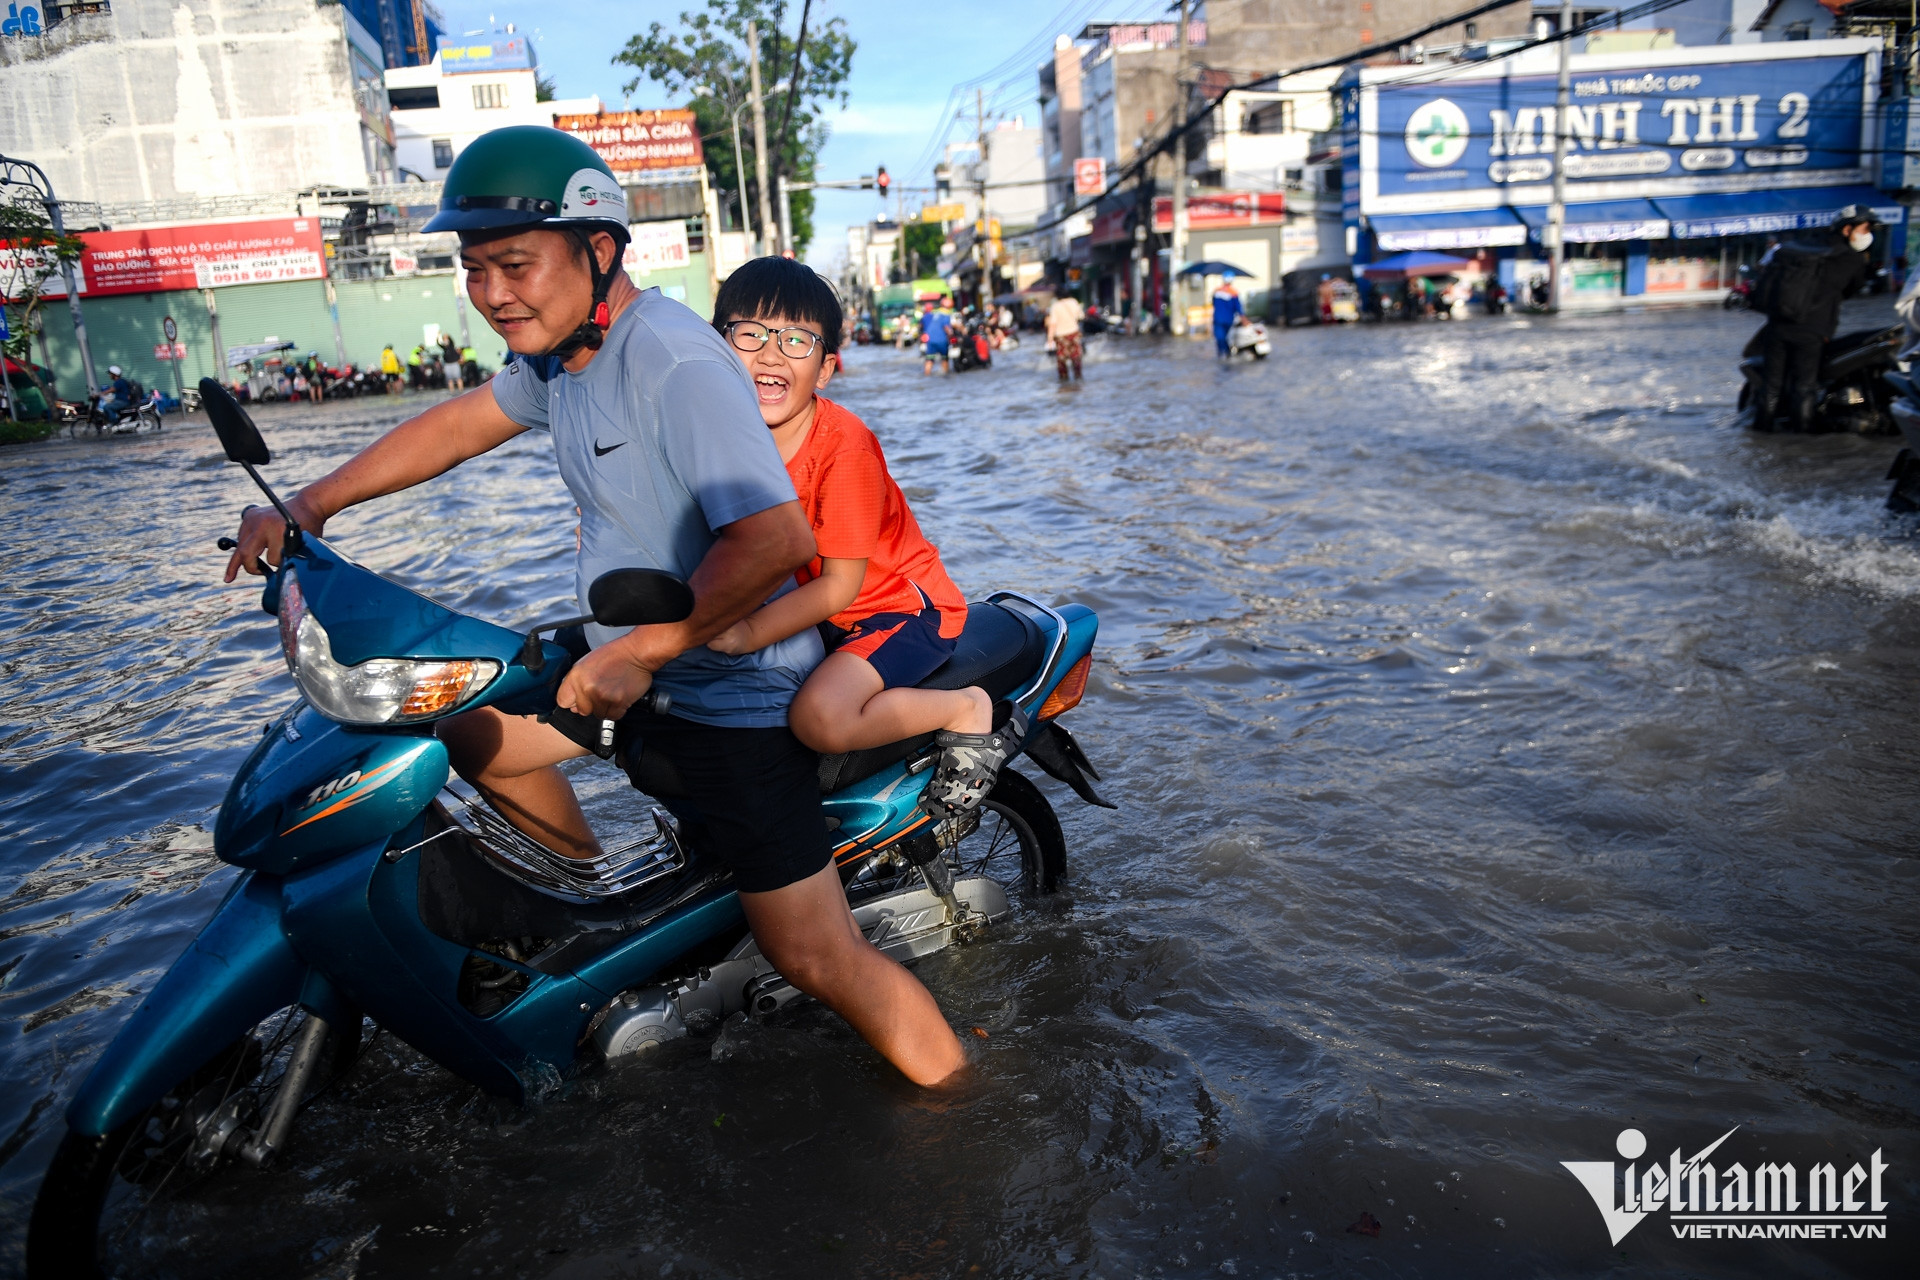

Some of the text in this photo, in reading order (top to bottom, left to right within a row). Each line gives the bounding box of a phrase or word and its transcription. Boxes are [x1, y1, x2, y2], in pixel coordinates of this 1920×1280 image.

[1611, 73, 1666, 95] THUỐC
[1667, 74, 1701, 91] GPP
[1489, 92, 1810, 156] MINH THI 2
[648, 142, 694, 159] NHANH
[92, 251, 125, 260] TRUNG
[126, 247, 147, 257] TÂM
[148, 246, 172, 257] DỊCH
[173, 245, 188, 255] VỤ
[252, 260, 277, 268] CHO
[303, 770, 361, 808] 110
